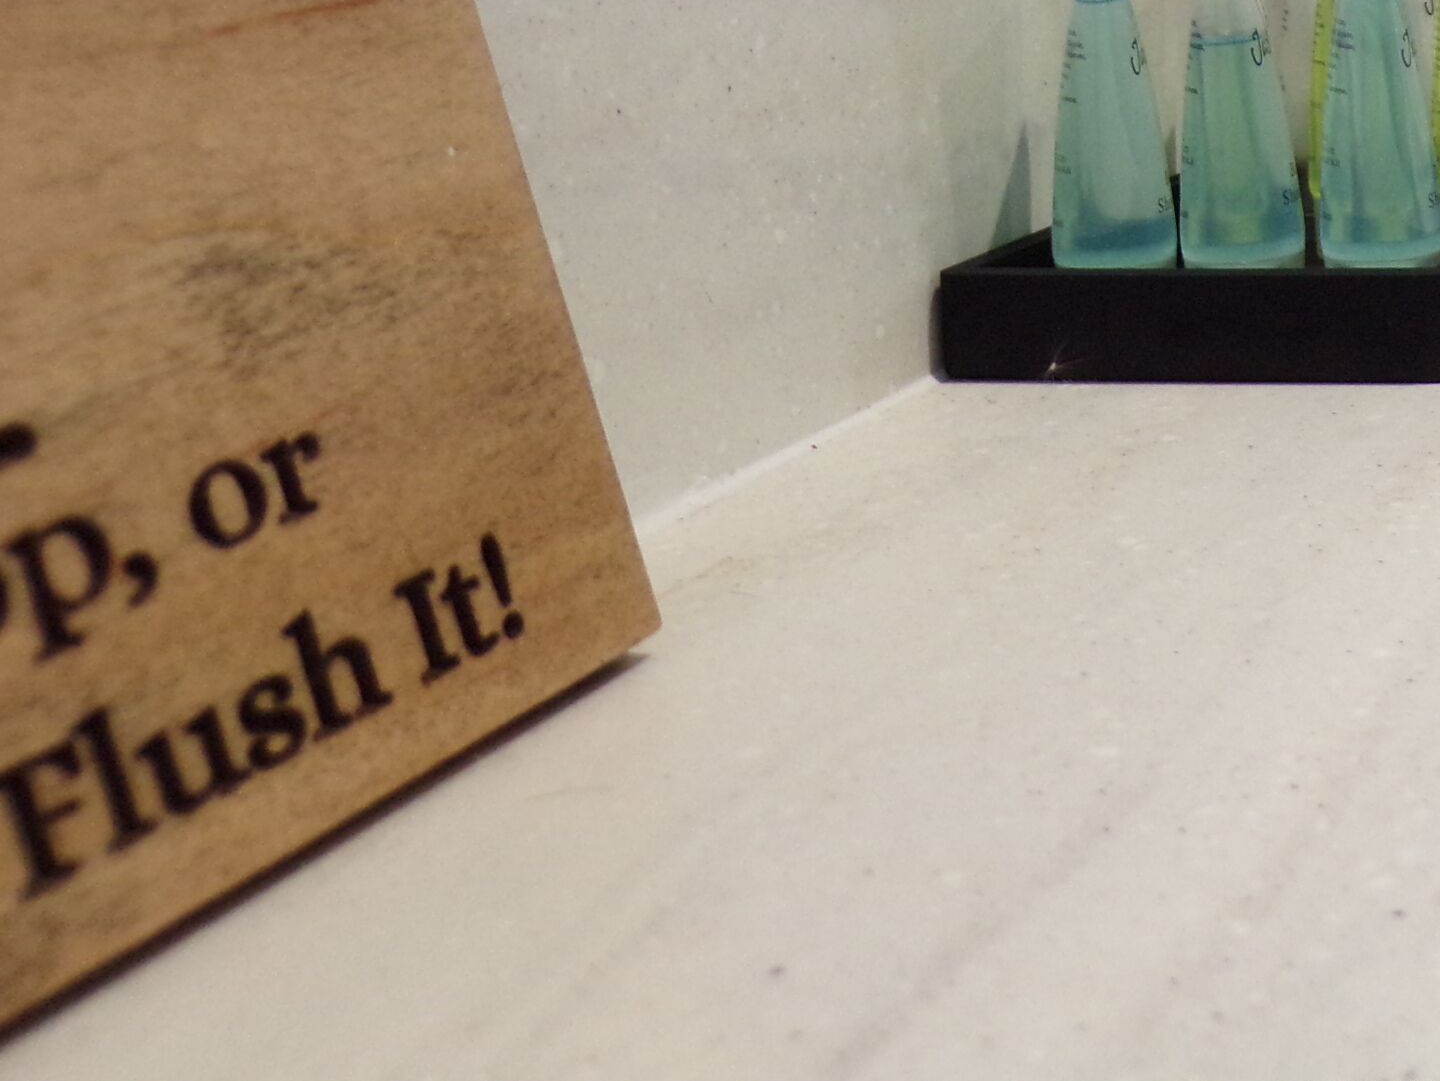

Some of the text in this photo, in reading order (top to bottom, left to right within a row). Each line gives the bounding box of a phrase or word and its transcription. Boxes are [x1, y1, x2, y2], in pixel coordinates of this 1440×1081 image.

[0, 431, 321, 666] p, or
[0, 531, 525, 903] Flush It!
